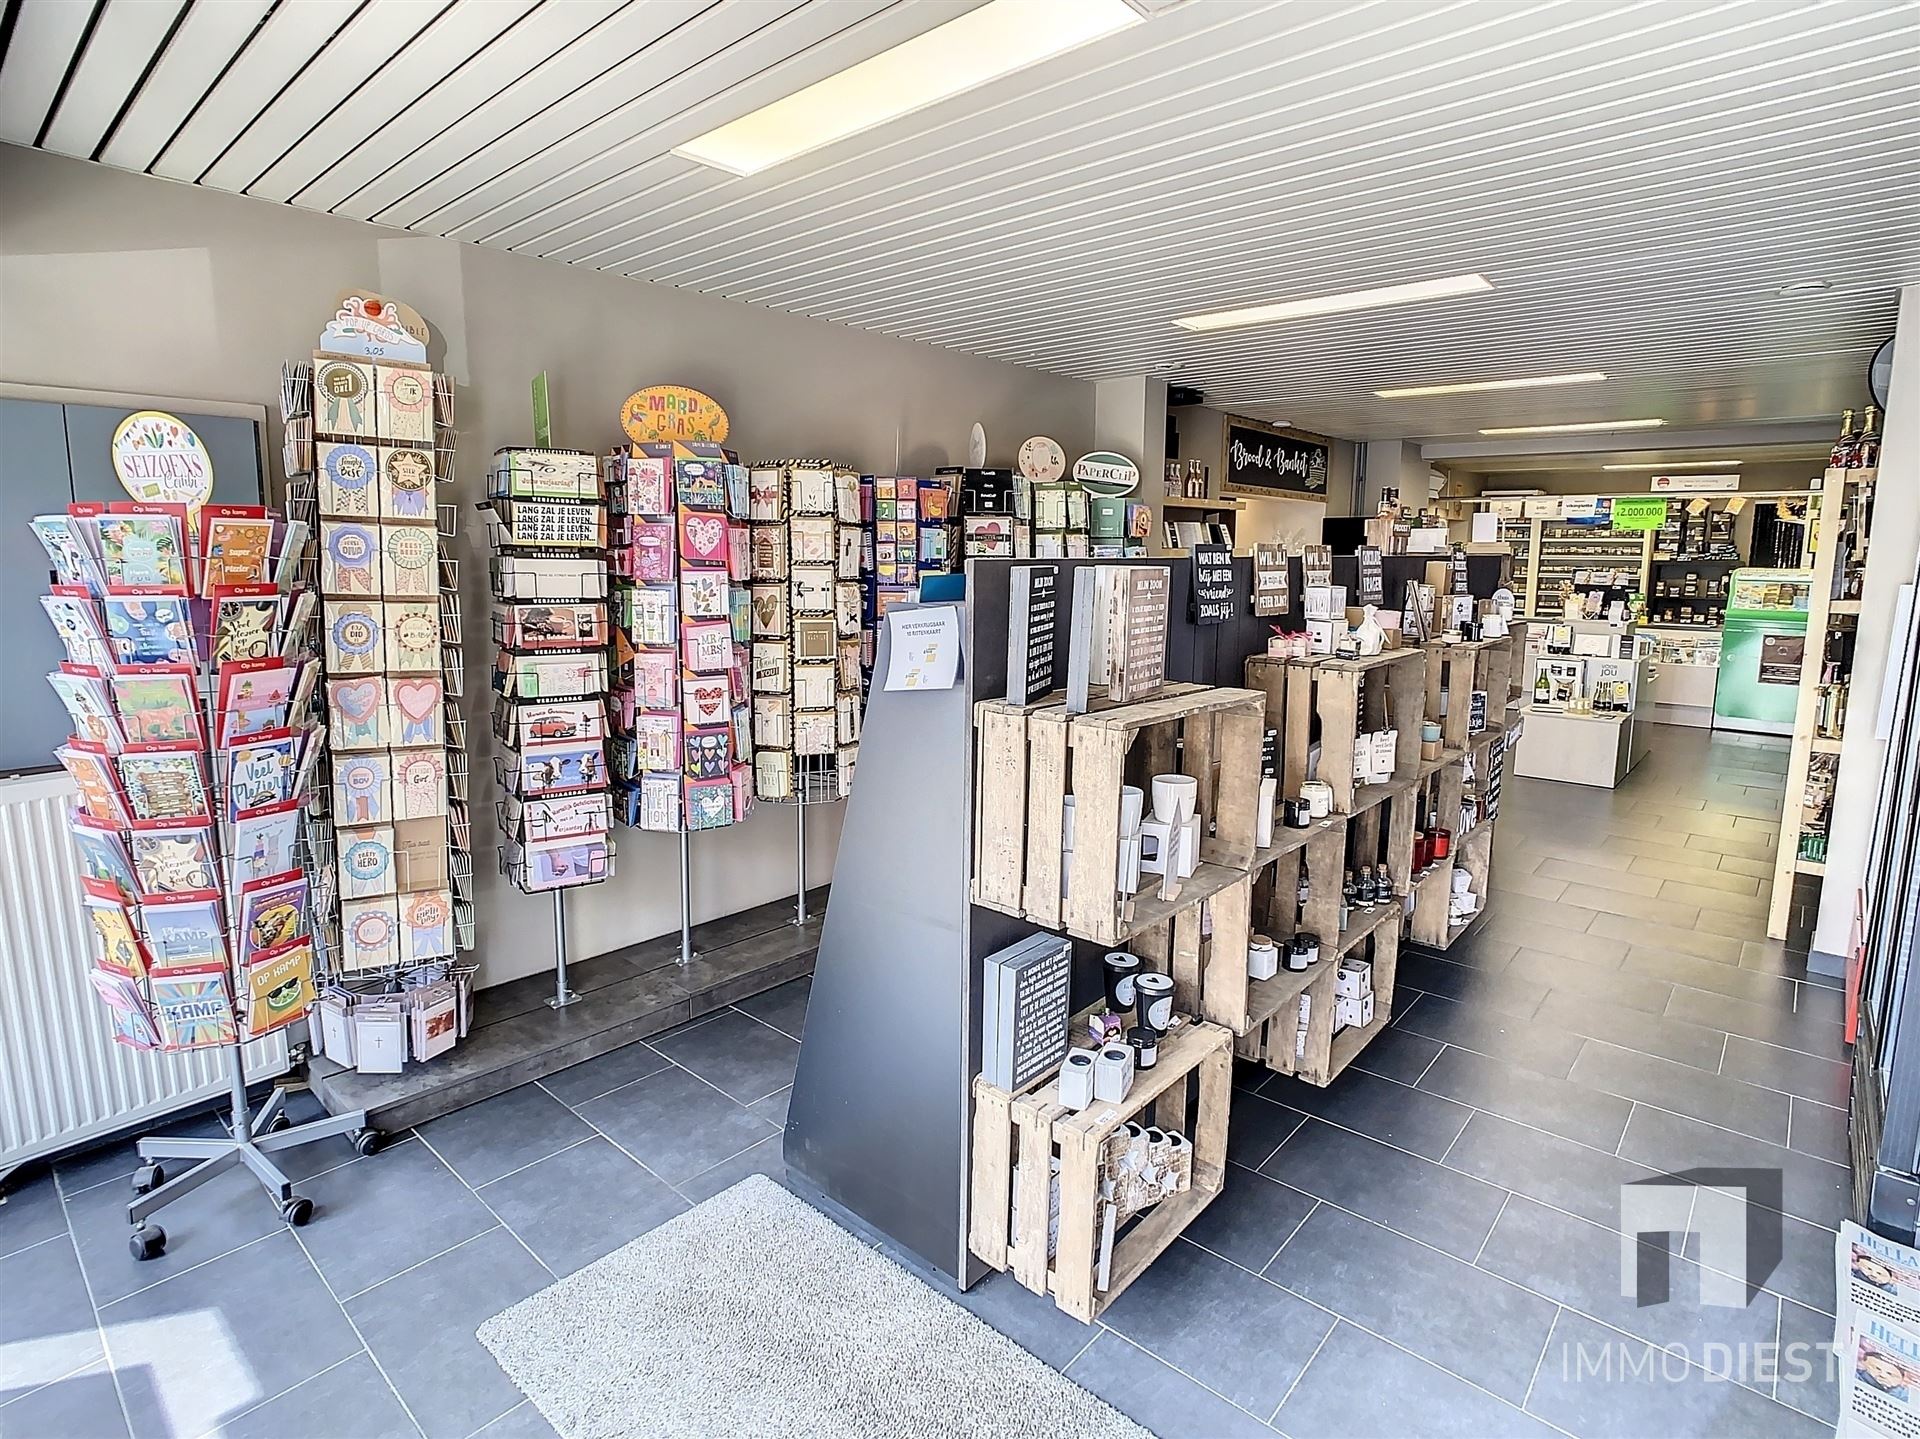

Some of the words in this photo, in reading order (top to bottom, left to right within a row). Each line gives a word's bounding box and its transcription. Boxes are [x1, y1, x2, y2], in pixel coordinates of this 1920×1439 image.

[364, 346, 385, 356] 3.05
[656, 413, 695, 436] GRAS
[1230, 439, 1264, 471] Brood
[1264, 448, 1272, 470] &
[1273, 447, 1309, 478] Banket
[122, 453, 204, 479] SEIZOENS
[532, 496, 580, 505] VERJAARDAG
[518, 506, 539, 514] LANG
[540, 506, 556, 515] ZAL
[557, 506, 566, 515] JE
[518, 514, 539, 523] LANG
[540, 515, 556, 524] ZAL
[557, 516, 566, 524] JE
[517, 524, 539, 532] LANG
[540, 524, 556, 532] ZAL
[557, 524, 566, 533] JE
[517, 532, 539, 540] LANG
[540, 532, 556, 541] ZAL
[557, 533, 566, 542] JE
[1198, 552, 1212, 565] WAT
[1213, 552, 1224, 565] BEN
[1224, 552, 1232, 565] IK
[1258, 552, 1273, 566] WIL
[1274, 552, 1286, 566] JIJ
[1306, 552, 1320, 566] WIL
[1320, 552, 1330, 565] JIJ
[1212, 570, 1223, 582] MET
[1223, 570, 1232, 582] EEN
[1200, 604, 1220, 618] ZOALS
[230, 619, 250, 632] Veel
[701, 634, 717, 646] MR
[702, 644, 722, 656] MRS
[761, 668, 776, 677] YOU
[536, 696, 583, 704] VERJAARDAG
[246, 760, 274, 781] Veel
[353, 777, 369, 785] BOY
[541, 790, 587, 799] VERJAARDAG
[357, 858, 378, 868] HERO
[256, 972, 271, 987] OP
[273, 954, 301, 978] KAMP
[166, 1000, 225, 1022] KAMP
